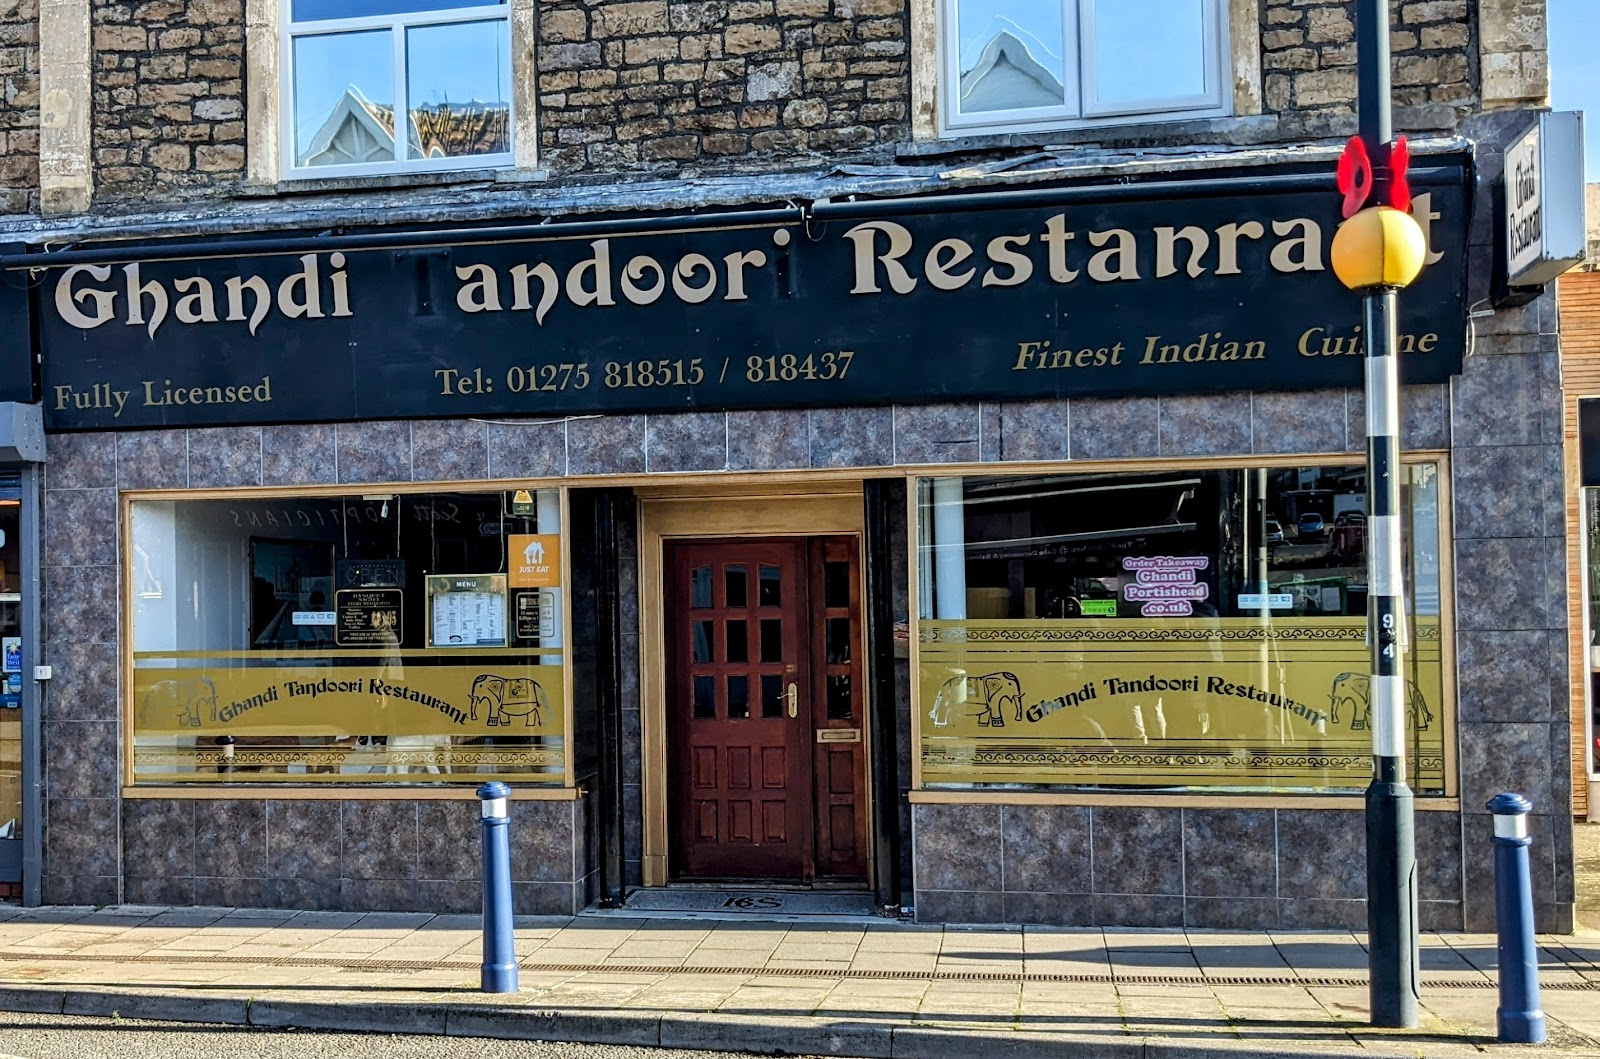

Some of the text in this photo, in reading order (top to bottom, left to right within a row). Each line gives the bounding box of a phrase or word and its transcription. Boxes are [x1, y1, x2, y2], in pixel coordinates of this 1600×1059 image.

[55, 251, 354, 339] Ghandi
[1012, 325, 1439, 372] Finest Indian Cuine
[434, 350, 855, 396] Tel: 01275 818515 / 818437
[53, 376, 273, 418] Fully Licensed
[519, 565, 550, 574] JUST EAT
[1125, 558, 1207, 567] Order Takeaway
[346, 567, 399, 583] OPEN
[1140, 570, 1192, 582] Ghandi
[1128, 586, 1205, 598] Portishead
[1145, 603, 1189, 613] .co.uk
[1382, 613, 1394, 629] 9
[1382, 643, 1394, 658] 4
[218, 677, 469, 726] Ghandi Tandoori Restaurant
[1025, 674, 1329, 727] Ghandi Tandoori Restaurant
